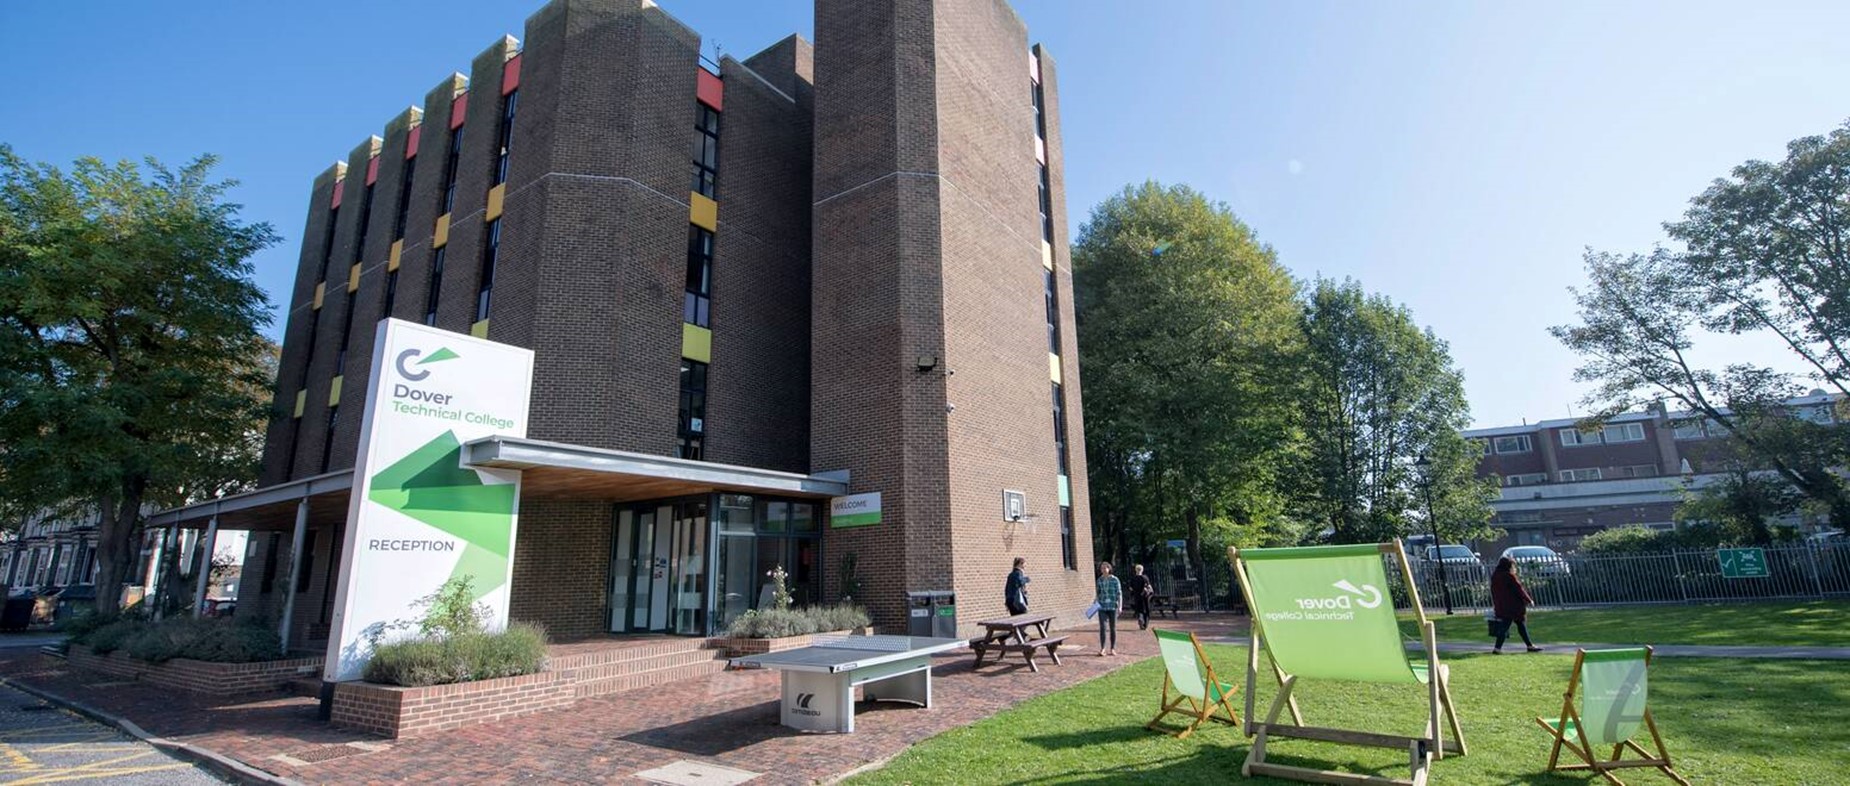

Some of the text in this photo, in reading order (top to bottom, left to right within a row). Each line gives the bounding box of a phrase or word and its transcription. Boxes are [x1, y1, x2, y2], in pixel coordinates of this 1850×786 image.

[394, 384, 453, 405] Dover
[393, 400, 514, 430] Technical College
[834, 500, 867, 510] WELCOME
[369, 539, 454, 551] RECEPTION
